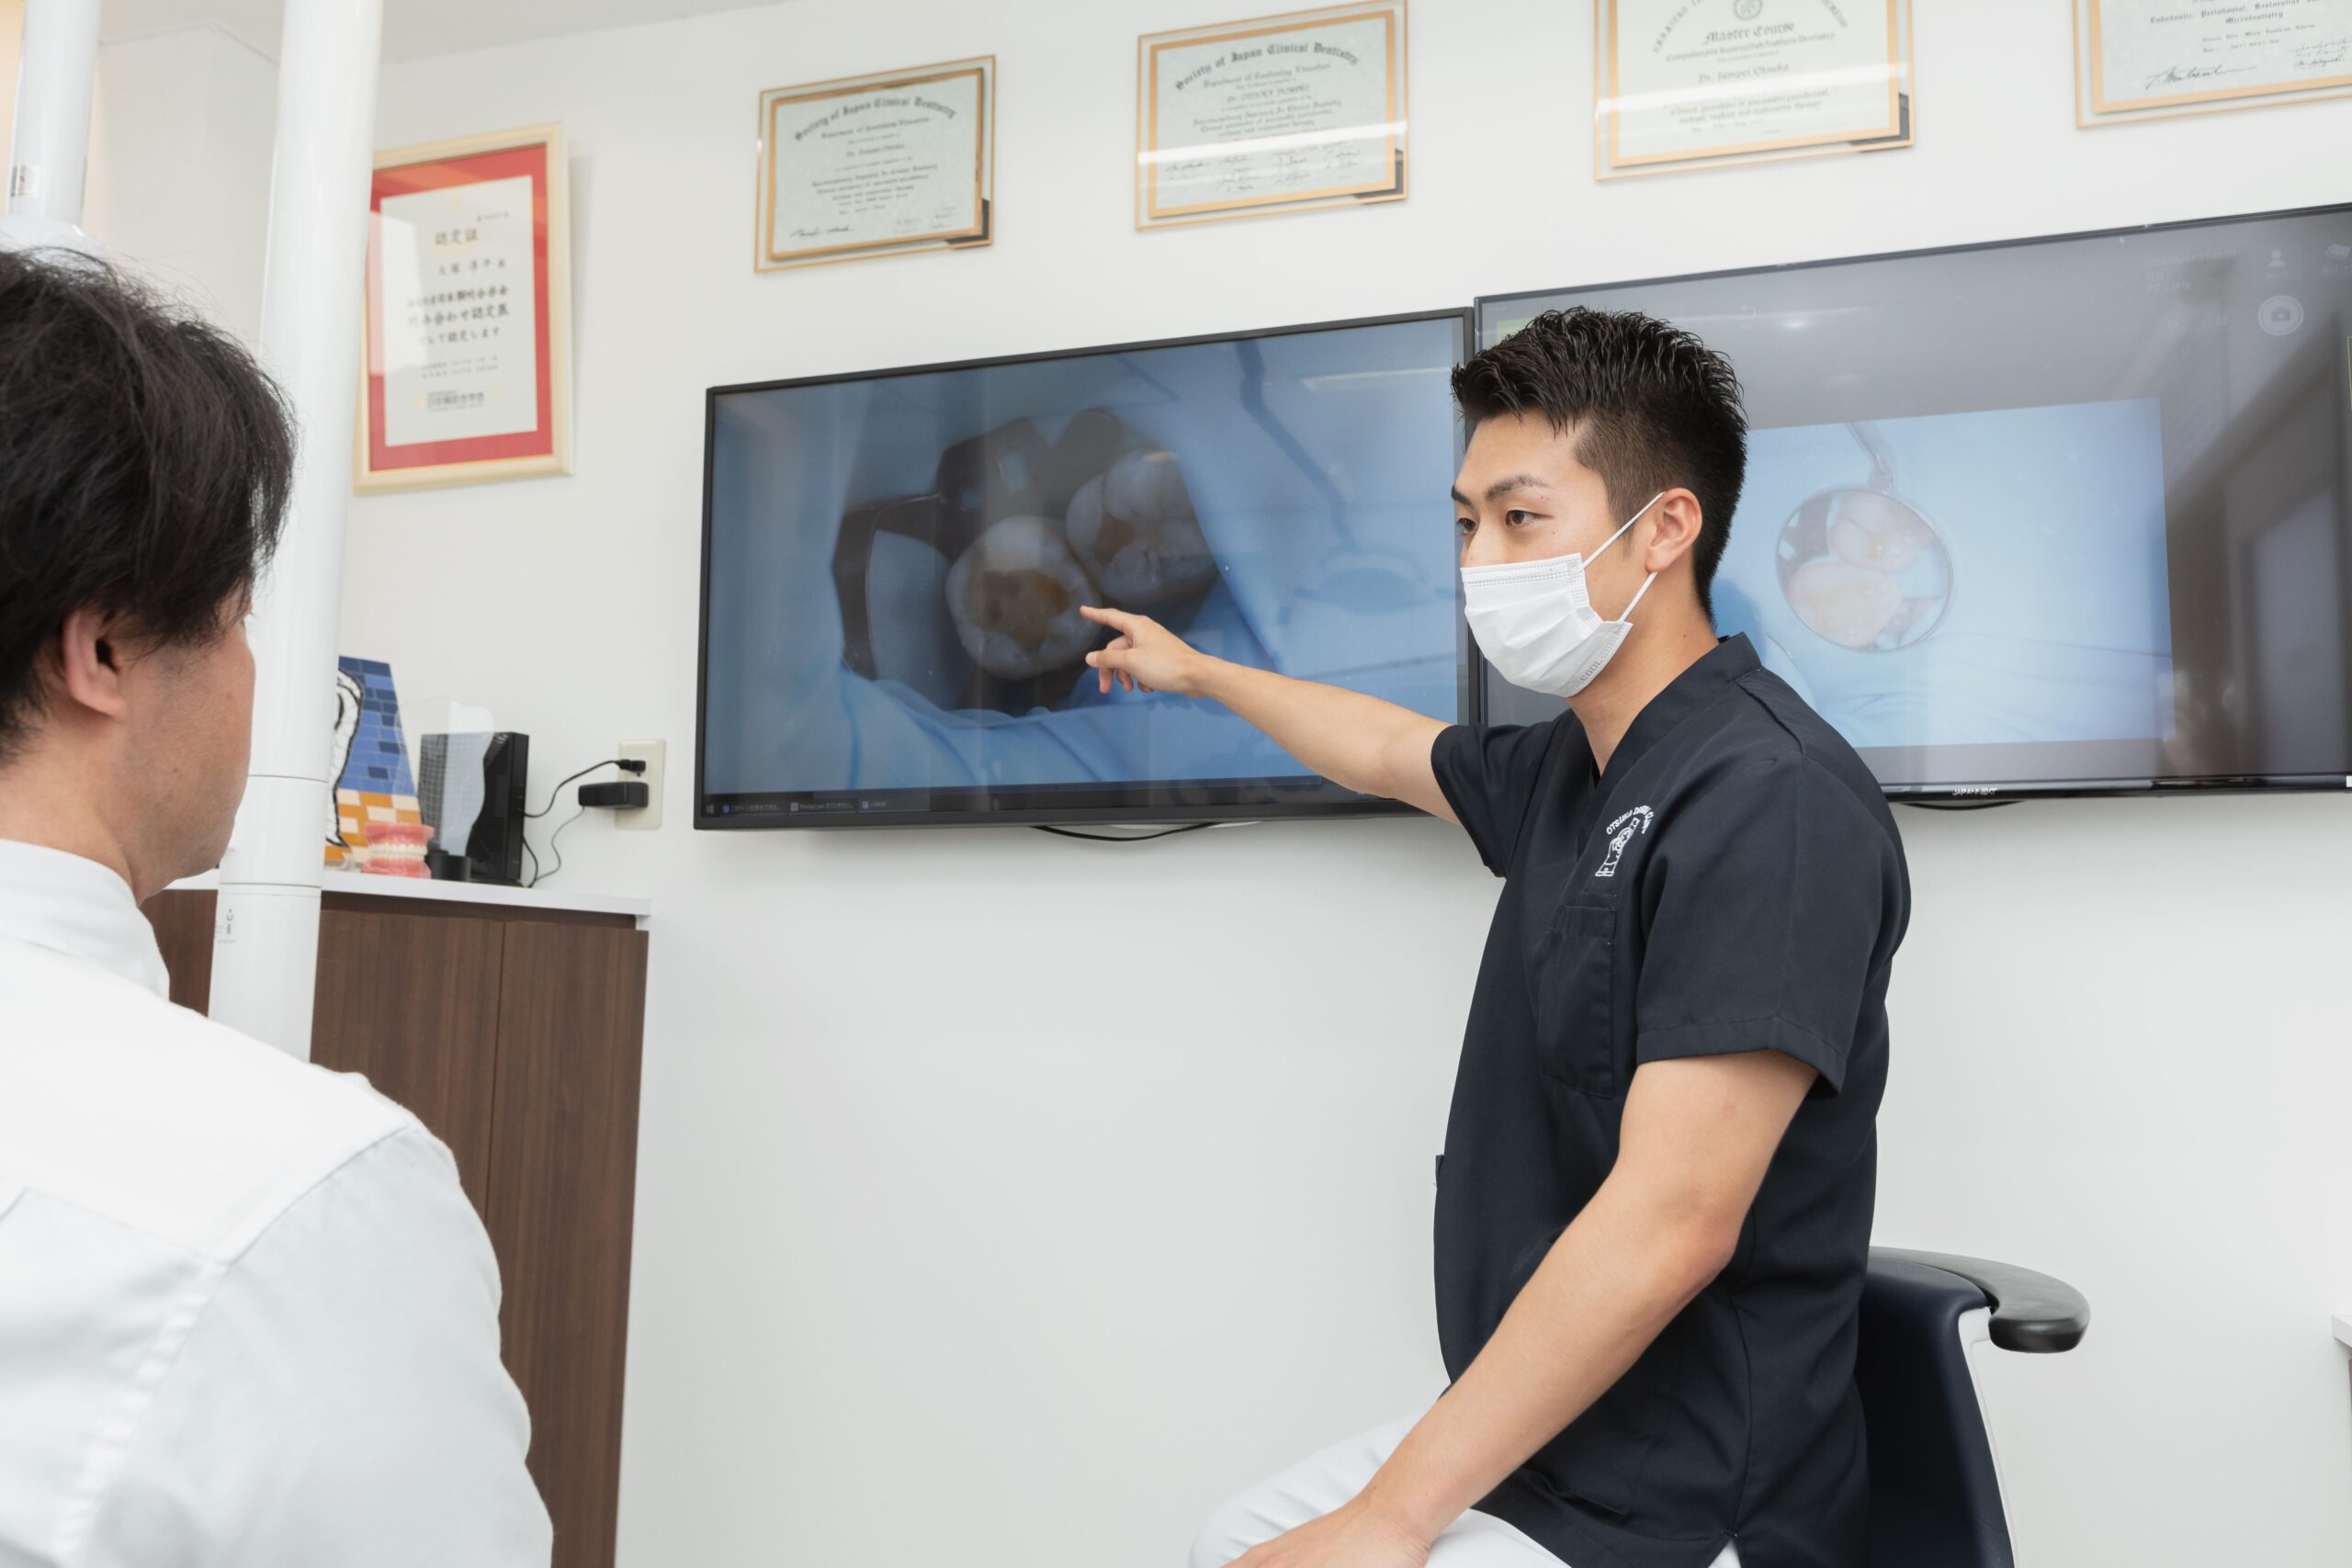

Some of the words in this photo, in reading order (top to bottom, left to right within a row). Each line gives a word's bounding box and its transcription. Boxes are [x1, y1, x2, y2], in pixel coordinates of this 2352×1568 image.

[1175, 64, 1212, 90] Society
[1215, 56, 1226, 68] of
[1230, 49, 1262, 62] Japan
[1267, 43, 1308, 55] Clinical
[1314, 42, 1360, 66] Dentistry
